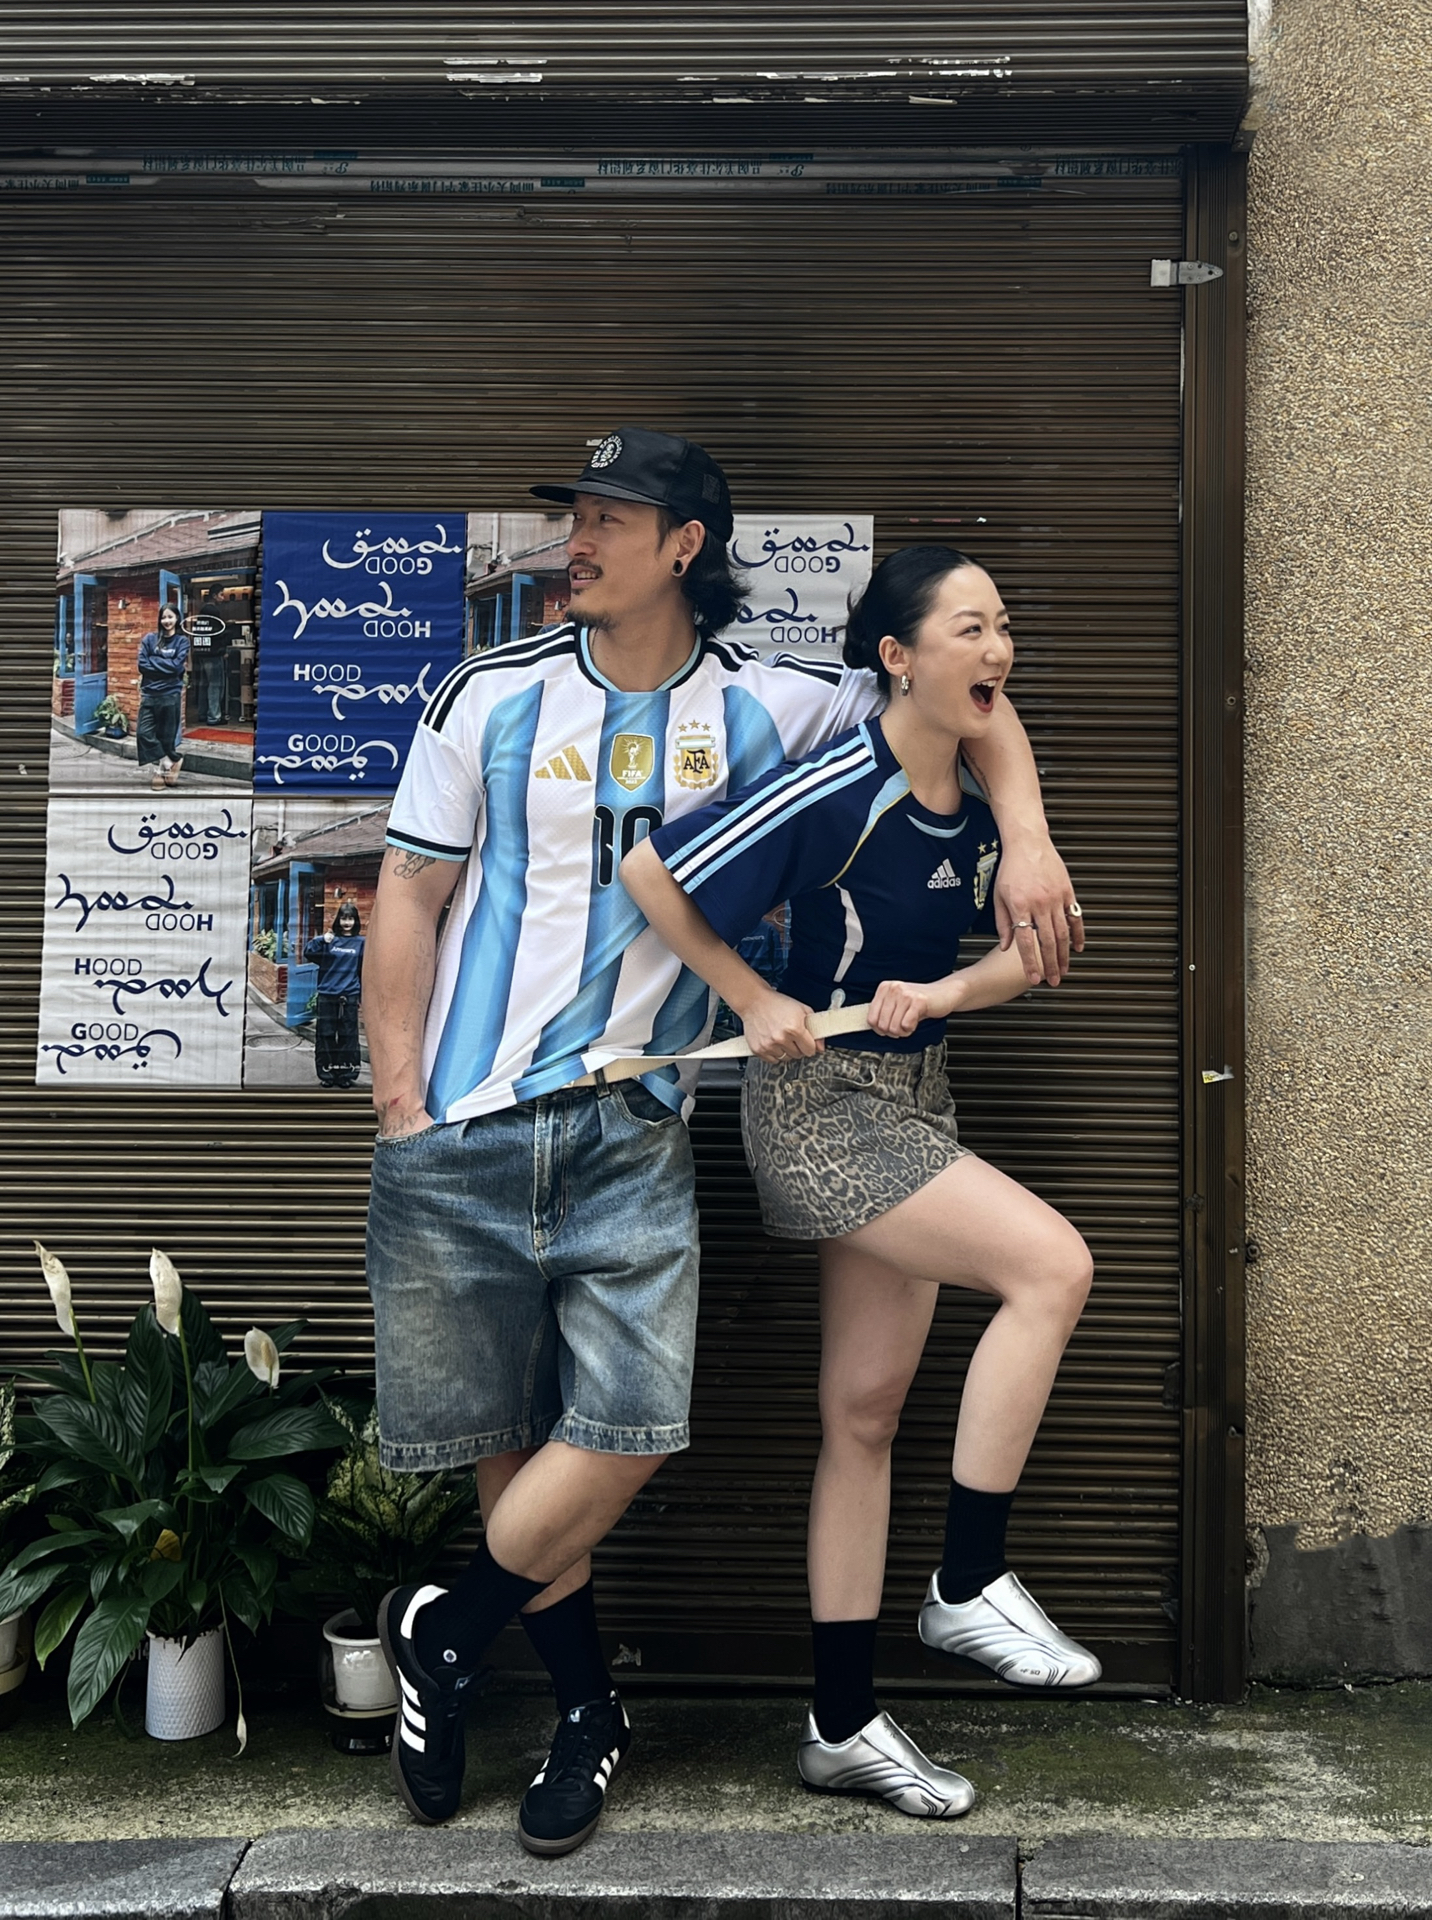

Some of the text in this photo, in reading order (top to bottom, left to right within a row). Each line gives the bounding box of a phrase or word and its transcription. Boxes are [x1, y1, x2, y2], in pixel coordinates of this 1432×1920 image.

[365, 556, 433, 575] GOOD
[774, 556, 841, 573] GOOD
[363, 620, 431, 638] HOOD
[770, 626, 837, 643] HOOD
[293, 664, 361, 682] HOOD
[287, 734, 356, 752] GOOD
[683, 748, 711, 774] AFA
[622, 769, 642, 777] FIFA
[150, 842, 218, 860] GOOD
[927, 876, 961, 889] adidas
[145, 914, 213, 931] HOOD
[74, 958, 142, 975] HOOD
[71, 1022, 139, 1041] GOOD
